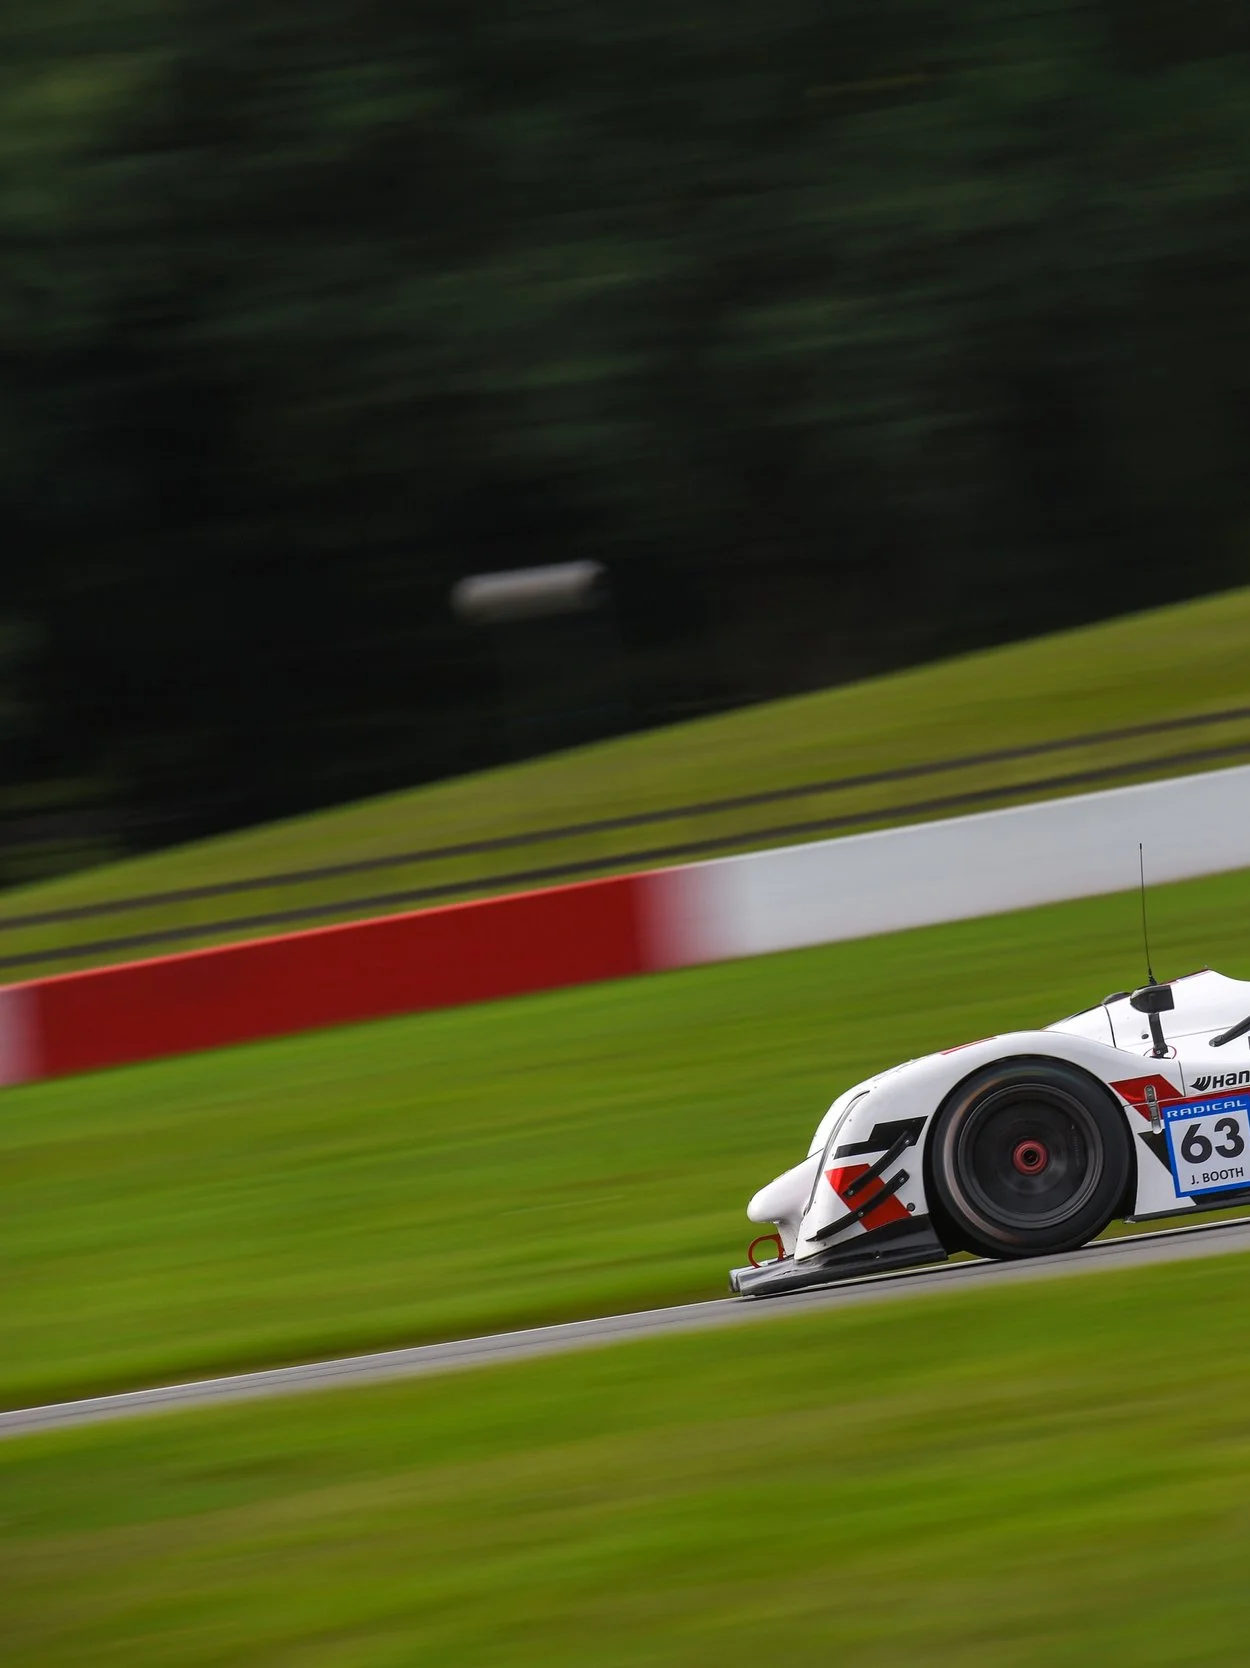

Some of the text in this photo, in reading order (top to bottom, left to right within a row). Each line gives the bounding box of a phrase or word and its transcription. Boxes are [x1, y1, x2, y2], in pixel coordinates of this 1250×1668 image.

[1166, 1099, 1247, 1118] RADICAL
[1181, 1117, 1245, 1164] 63
[1191, 1166, 1244, 1185] J. BOOTH
